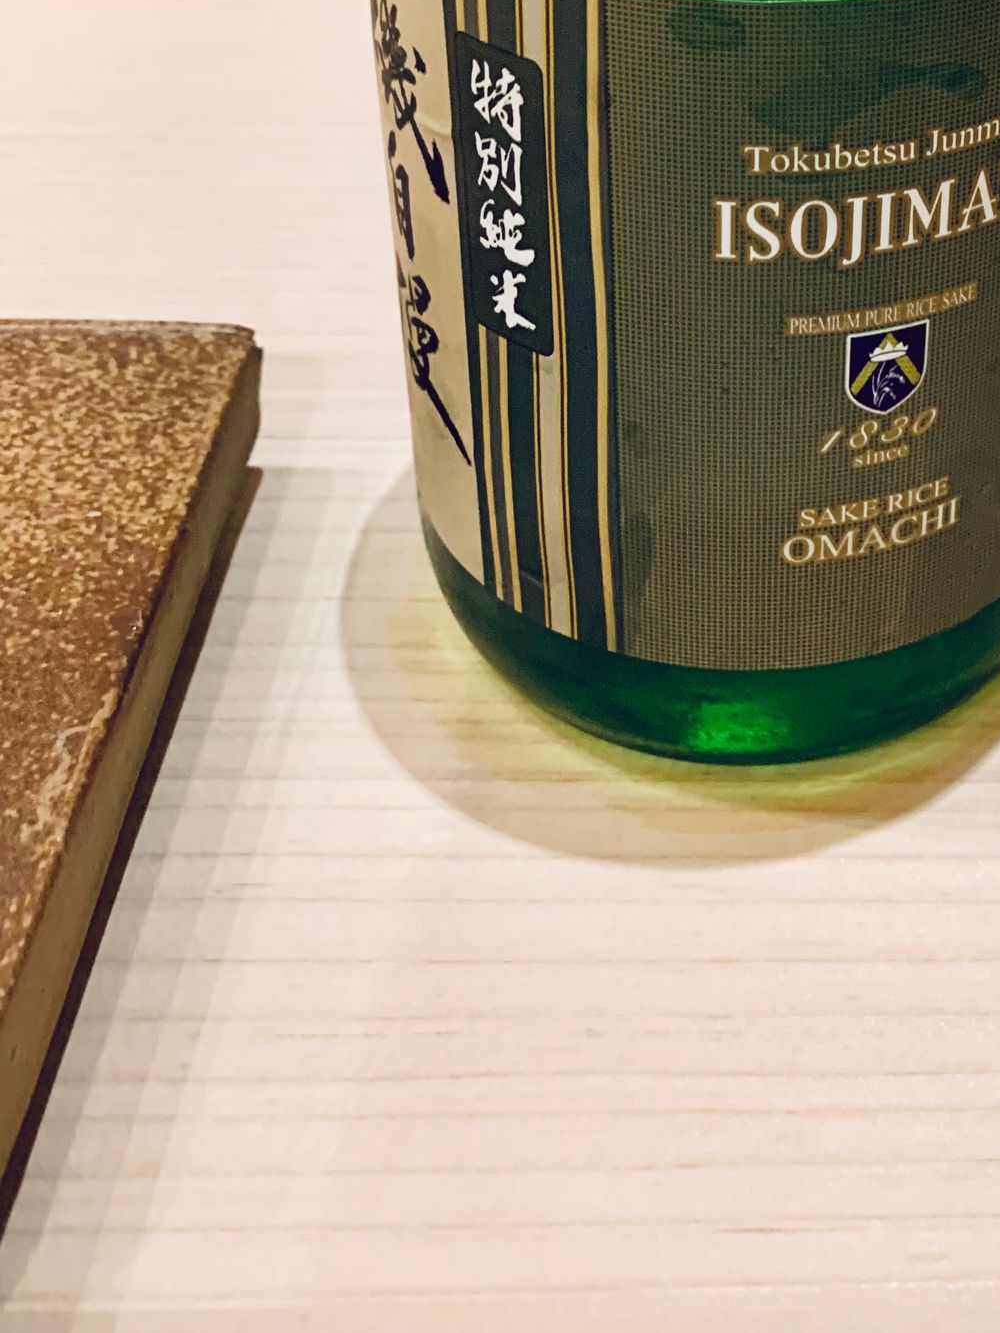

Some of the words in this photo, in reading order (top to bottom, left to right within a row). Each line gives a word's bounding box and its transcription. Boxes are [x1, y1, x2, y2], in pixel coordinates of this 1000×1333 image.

[744, 140, 917, 173] Tokubetsu
[470, 58, 537, 332] 特別純米
[789, 313, 861, 335] PREMIUM
[864, 305, 901, 327] PURE
[906, 296, 939, 318] RICE
[942, 284, 977, 309] SAKE
[820, 407, 937, 454] 1830
[852, 445, 909, 467] since
[800, 498, 879, 528] SAKE
[887, 475, 950, 514] RICE
[782, 497, 960, 564] OMACHI
